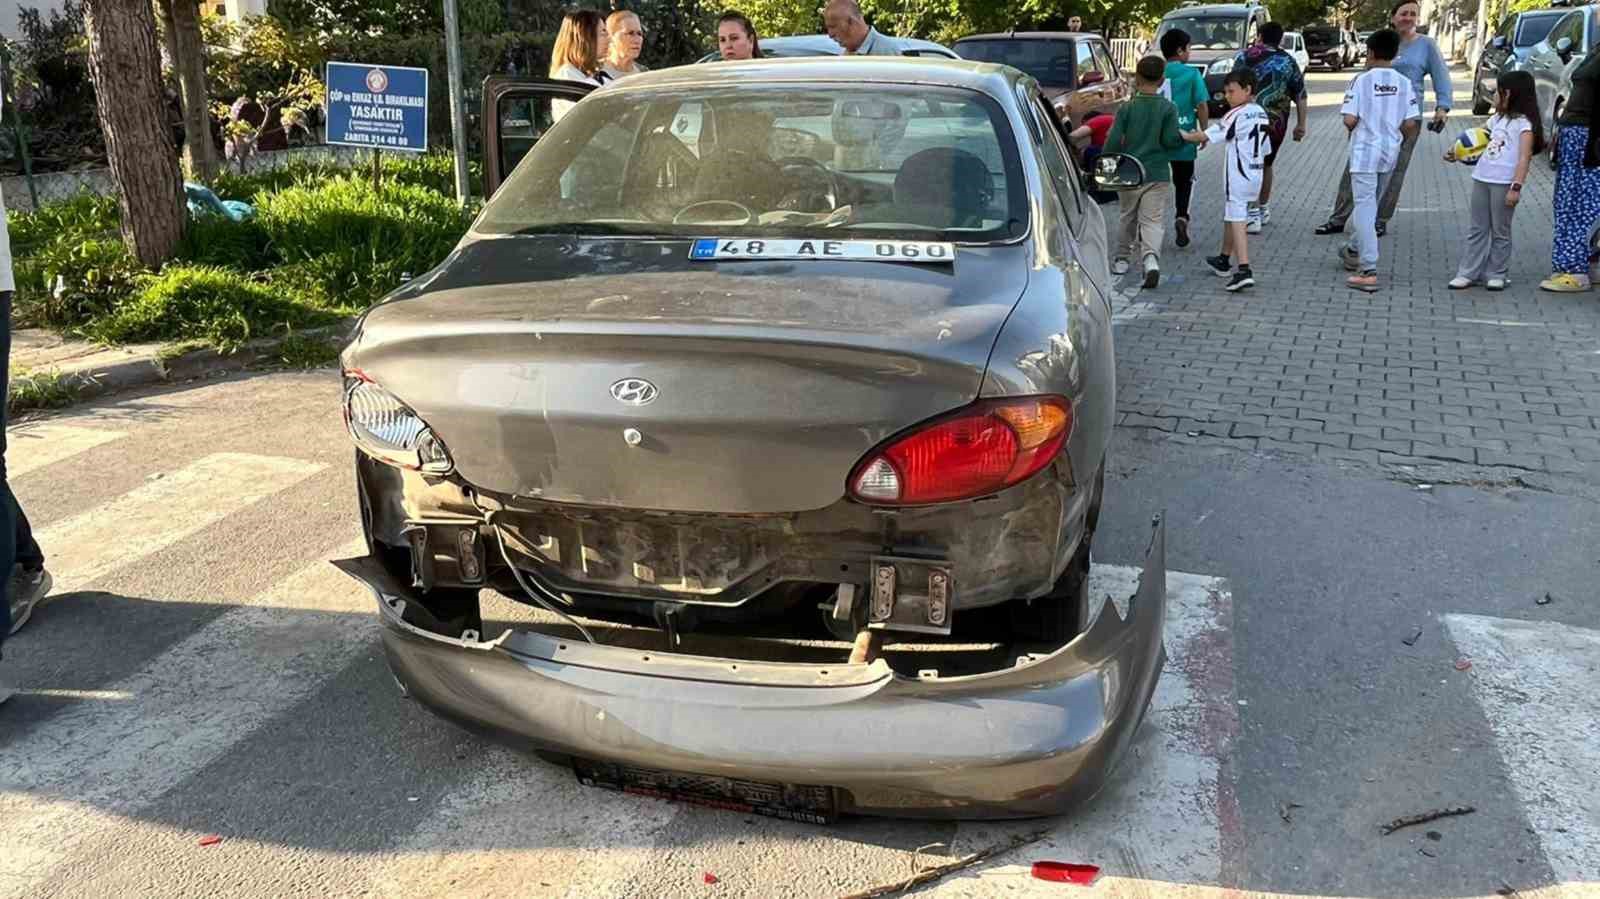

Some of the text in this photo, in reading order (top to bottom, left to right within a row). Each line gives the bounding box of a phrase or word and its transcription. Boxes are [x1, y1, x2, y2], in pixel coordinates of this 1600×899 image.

[1374, 83, 1397, 93] beko
[350, 105, 403, 121] YASAKTIR
[720, 240, 946, 258] 48 AE 060
